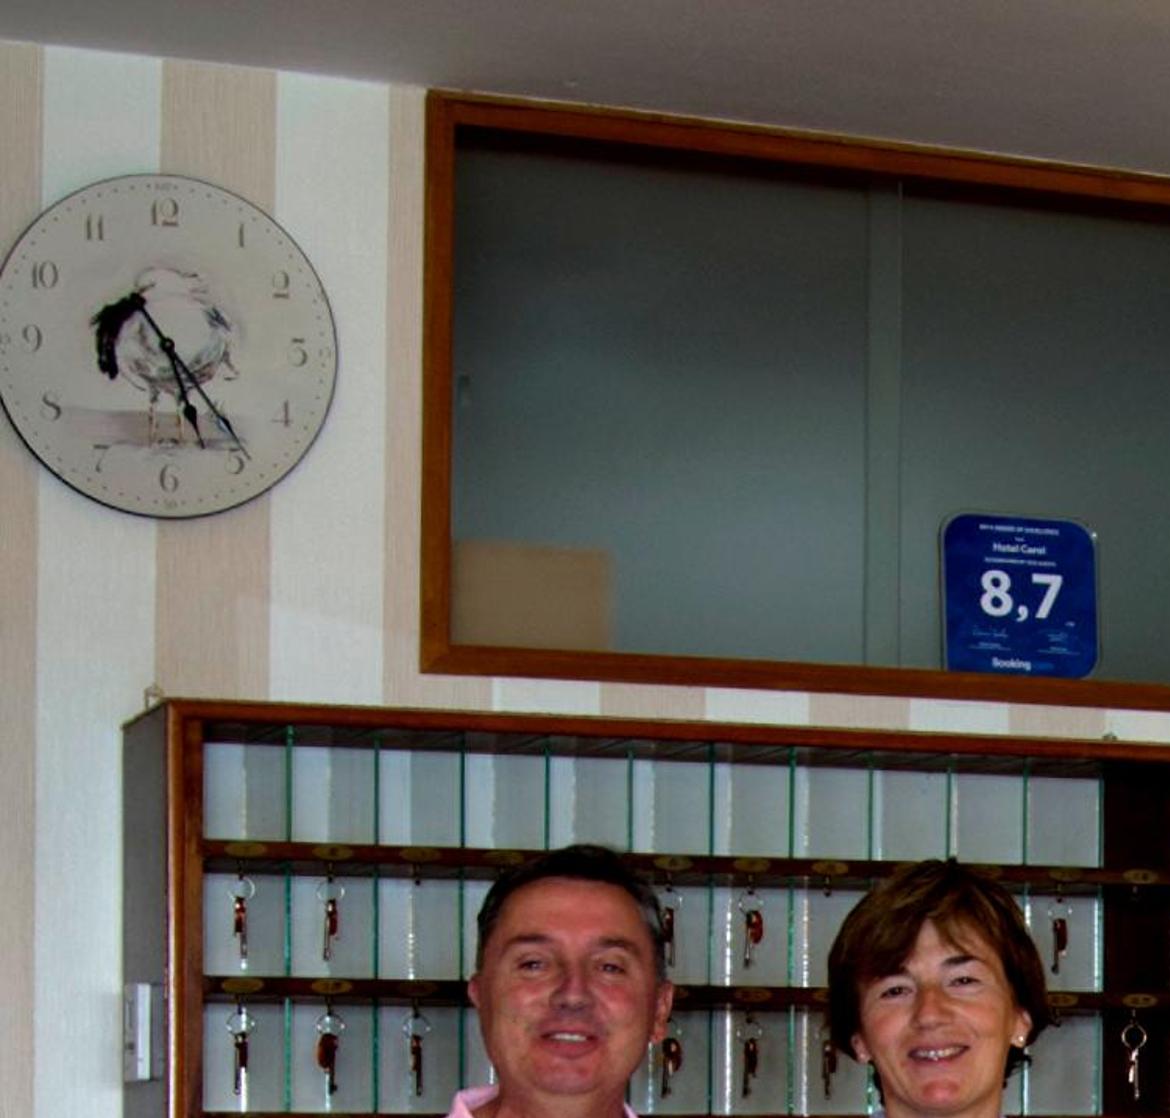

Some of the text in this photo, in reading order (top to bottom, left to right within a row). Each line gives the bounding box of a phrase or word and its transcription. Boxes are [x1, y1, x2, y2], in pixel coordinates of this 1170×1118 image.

[151, 198, 179, 227] 12
[86, 214, 105, 241] 11
[238, 223, 246, 248] 1
[32, 261, 59, 289] 10
[272, 270, 290, 299] 2
[22, 325, 43, 352] 9
[288, 338, 308, 368] 3
[41, 391, 62, 421] 8
[271, 400, 293, 428] 4
[94, 444, 110, 473] 7
[225, 446, 245, 475] 5
[160, 464, 179, 493] 6
[992, 542, 1019, 554] Hotel
[980, 569, 1063, 622] 8,7
